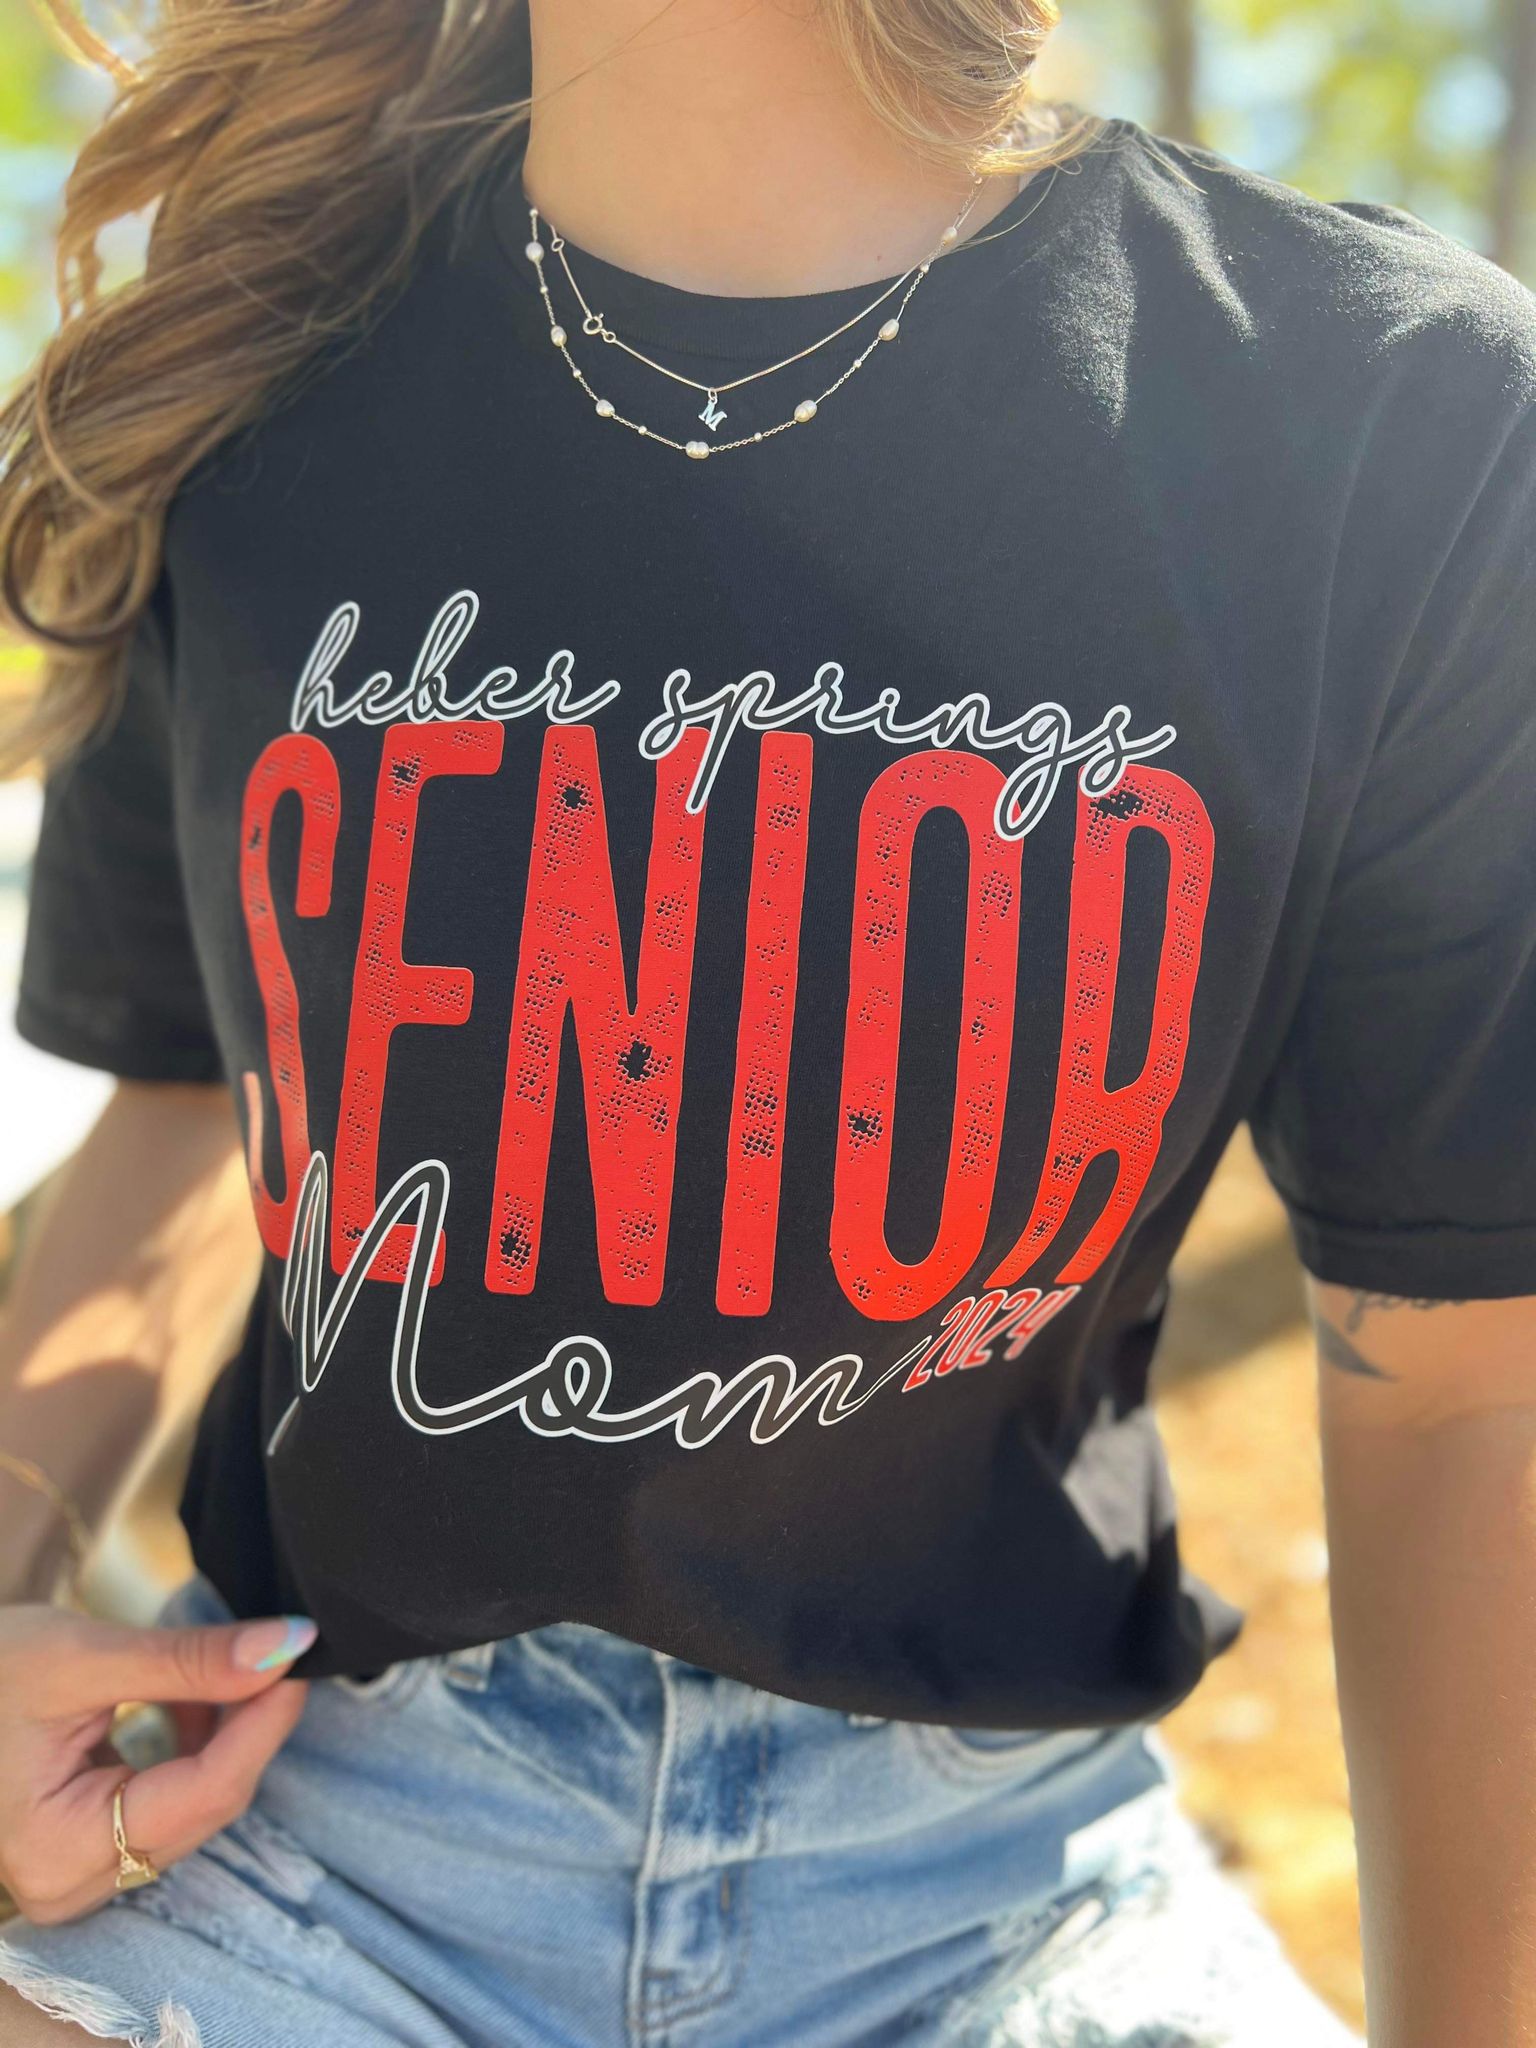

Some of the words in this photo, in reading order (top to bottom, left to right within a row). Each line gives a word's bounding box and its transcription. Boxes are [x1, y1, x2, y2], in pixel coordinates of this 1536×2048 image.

[698, 399, 728, 431] M
[290, 589, 621, 731] heber
[639, 662, 1177, 840] springs
[241, 720, 1215, 1321] SENIOR
[902, 1285, 1081, 1393] 2024
